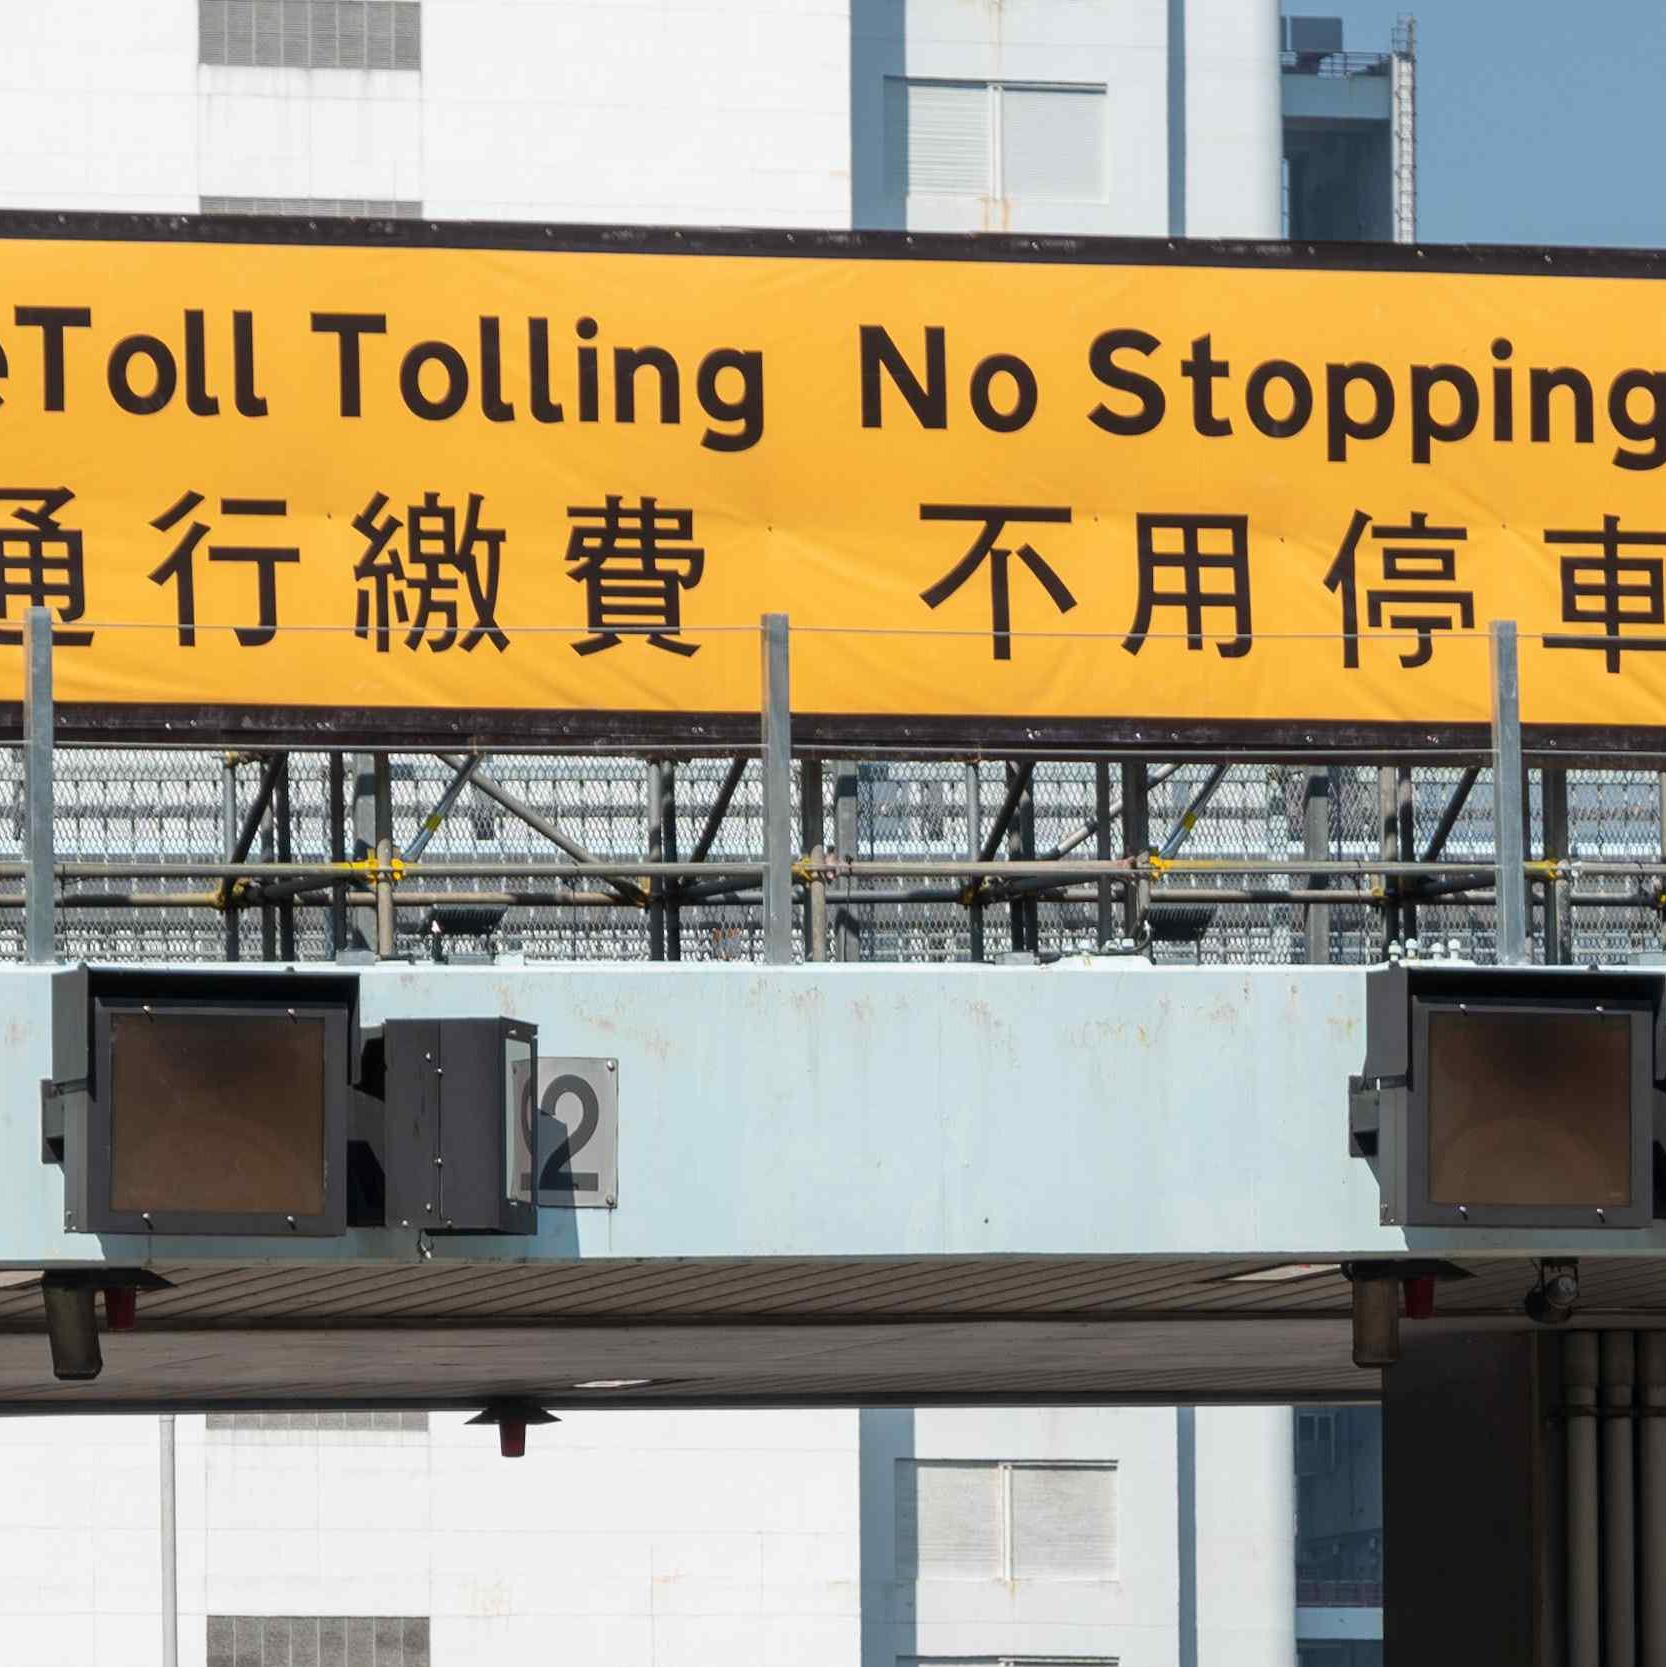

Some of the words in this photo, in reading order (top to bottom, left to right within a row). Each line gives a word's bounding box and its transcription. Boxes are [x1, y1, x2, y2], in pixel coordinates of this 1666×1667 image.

[310, 312, 764, 453] Tolling
[860, 325, 1038, 433] No
[538, 1073, 600, 1192] 2
